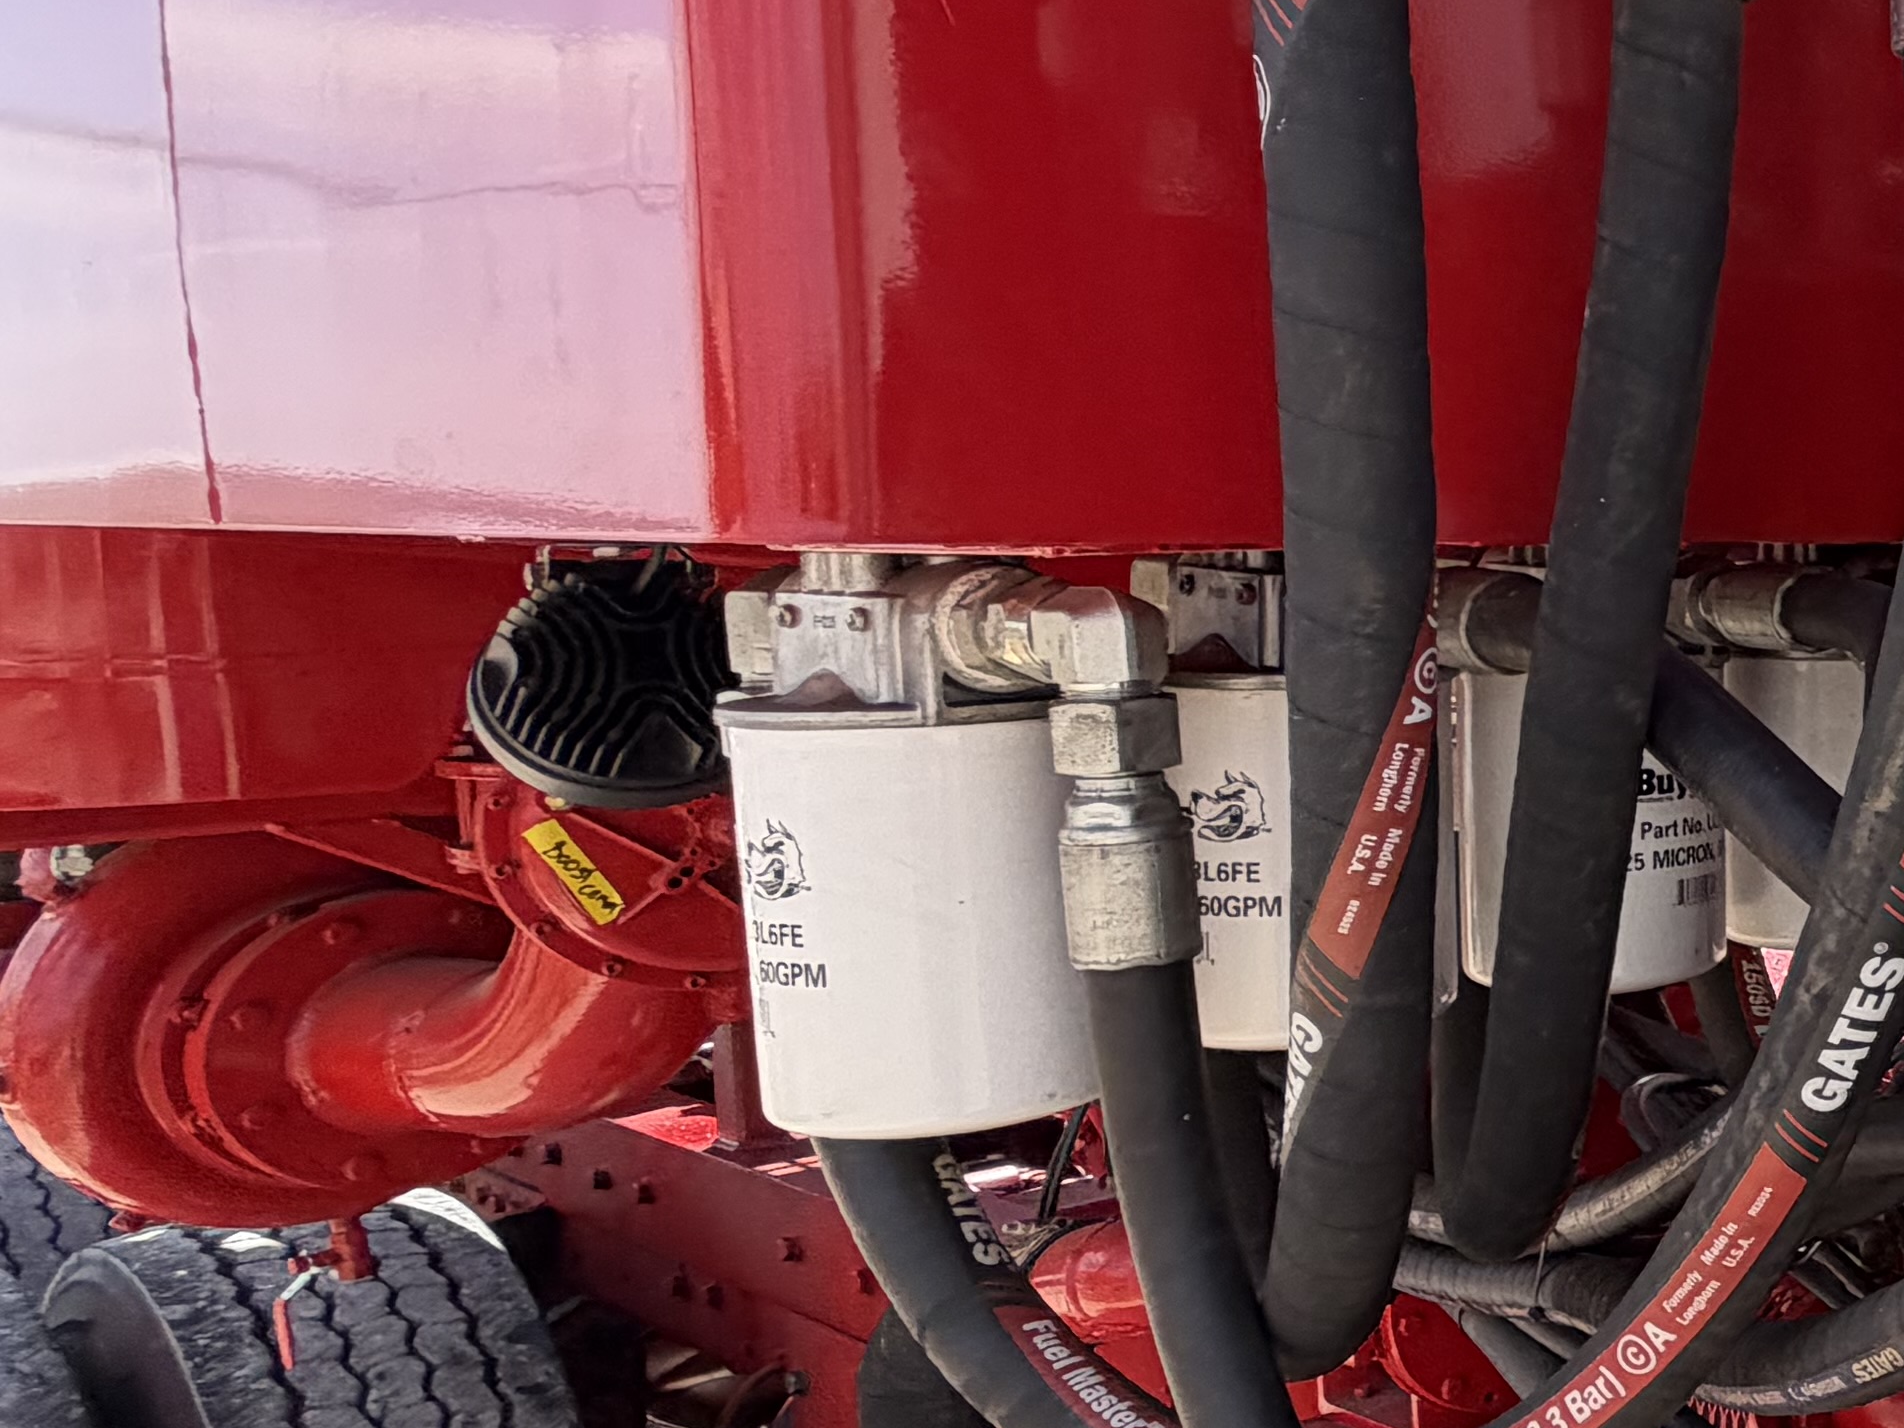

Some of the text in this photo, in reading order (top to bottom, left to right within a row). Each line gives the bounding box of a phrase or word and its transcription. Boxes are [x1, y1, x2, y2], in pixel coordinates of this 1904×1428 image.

[1371, 741, 1410, 813] Longhorn
[1393, 746, 1426, 814] Formerly
[1640, 819, 1679, 840] Part
[1197, 894, 1283, 918] 60GPM
[1661, 1269, 1704, 1314] Formerly
[1675, 1279, 1722, 1326] Longhorn
[1021, 1318, 1085, 1370] Fuel
[1563, 1365, 1628, 1424] Bar)
